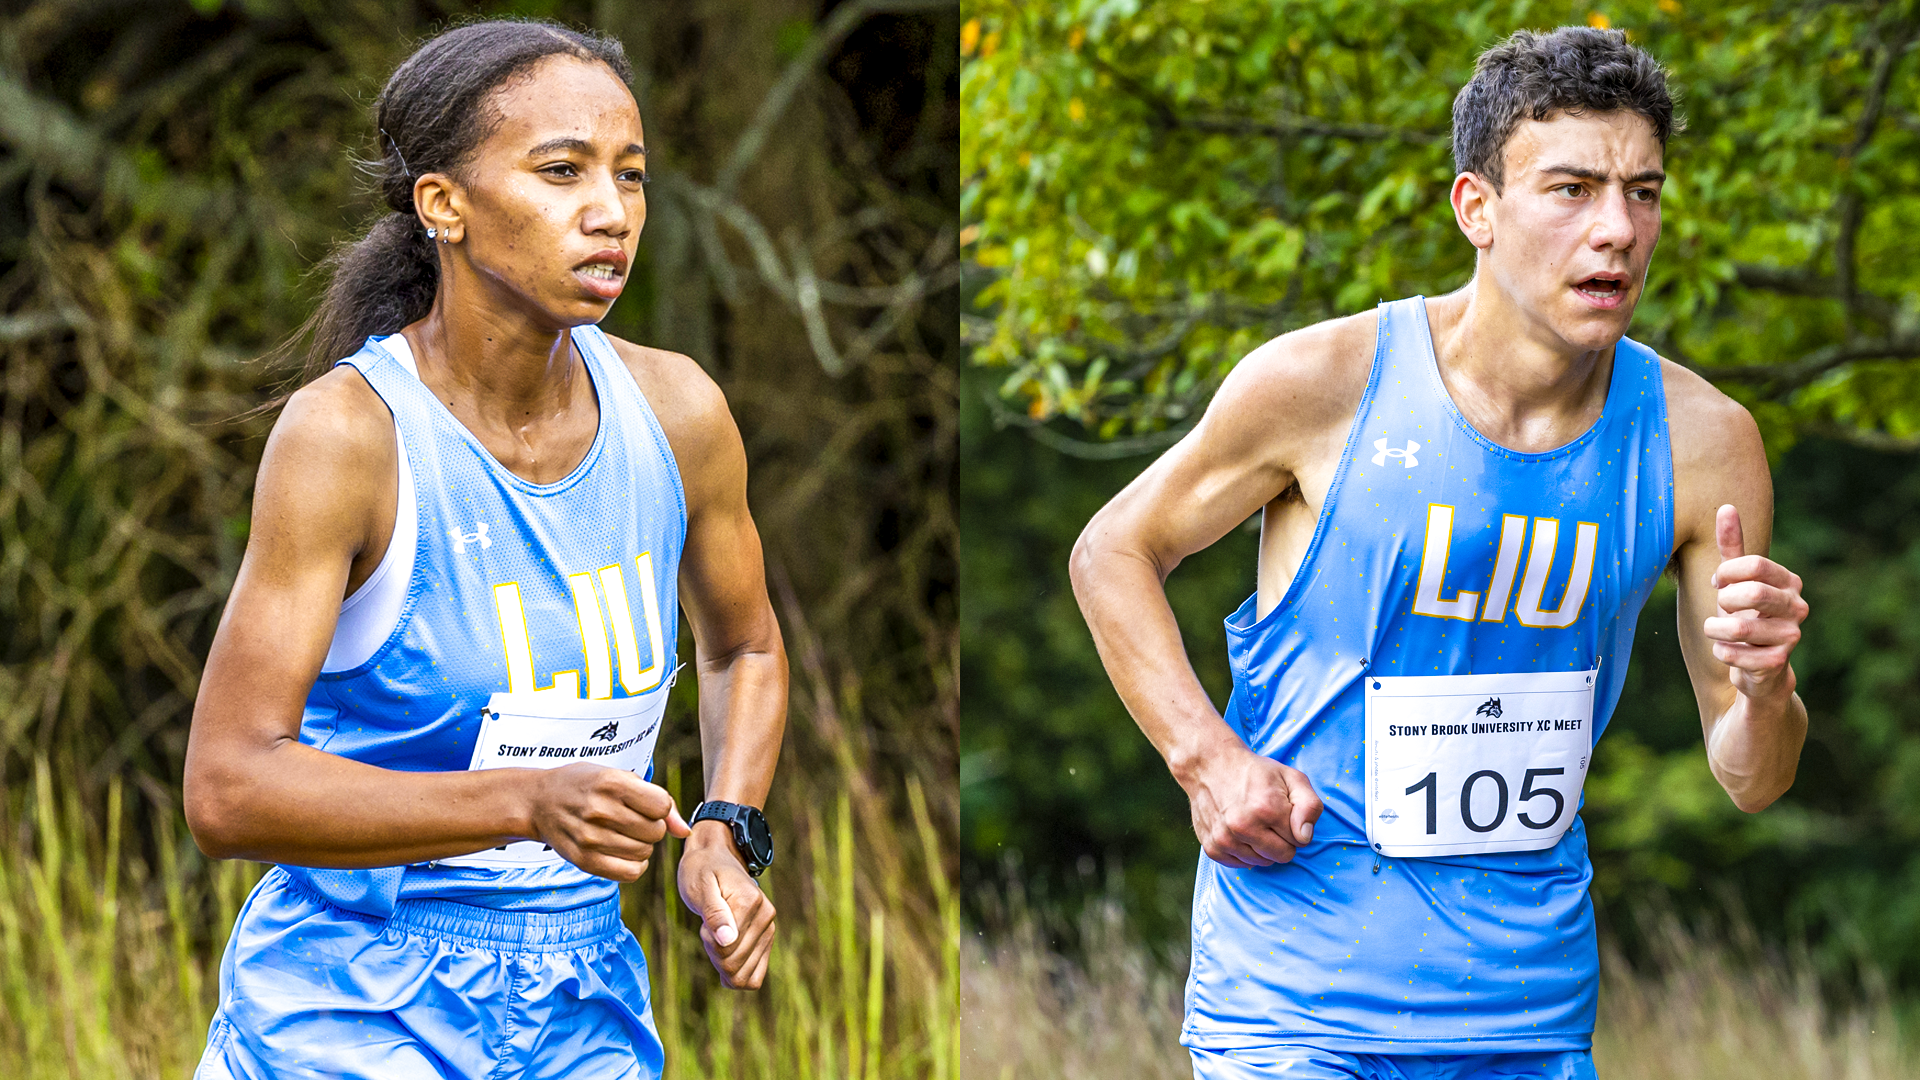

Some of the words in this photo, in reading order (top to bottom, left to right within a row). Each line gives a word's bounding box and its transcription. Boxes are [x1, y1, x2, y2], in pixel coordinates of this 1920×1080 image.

[1411, 503, 1599, 629] LIU
[493, 551, 665, 700] LIU
[498, 744, 537, 757] STONY
[539, 746, 578, 758] BROOK
[579, 737, 636, 758] UNIVERSITY
[1389, 724, 1427, 736] STONY
[1431, 724, 1468, 736] BROOK
[1471, 721, 1534, 734] UNIVERSITY
[1536, 719, 1551, 732] XC
[1554, 719, 1582, 731] MEET
[1405, 767, 1565, 834] 105
